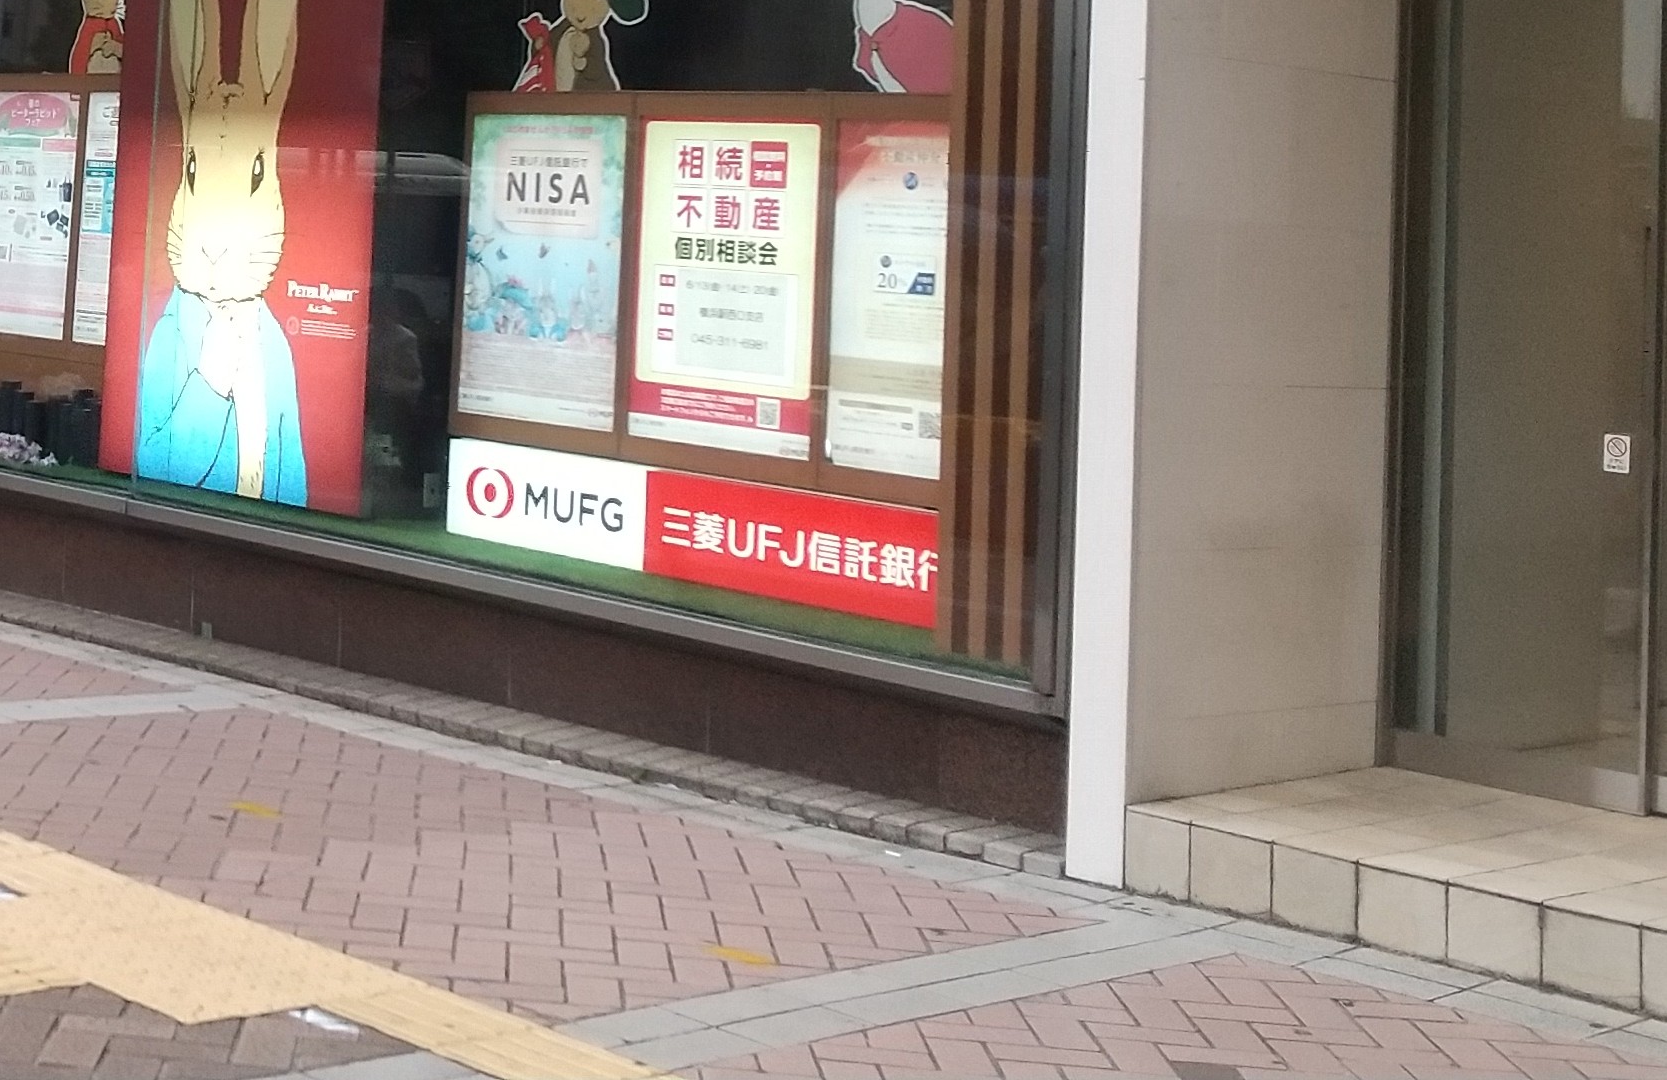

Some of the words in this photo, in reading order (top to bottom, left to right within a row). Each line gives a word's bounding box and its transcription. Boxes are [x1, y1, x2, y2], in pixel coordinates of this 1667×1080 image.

[678, 145, 744, 181] 相続
[507, 171, 591, 206] NISA
[676, 194, 781, 232] 不動産
[674, 236, 779, 267] 個別相談会
[525, 482, 624, 533] MUFG
